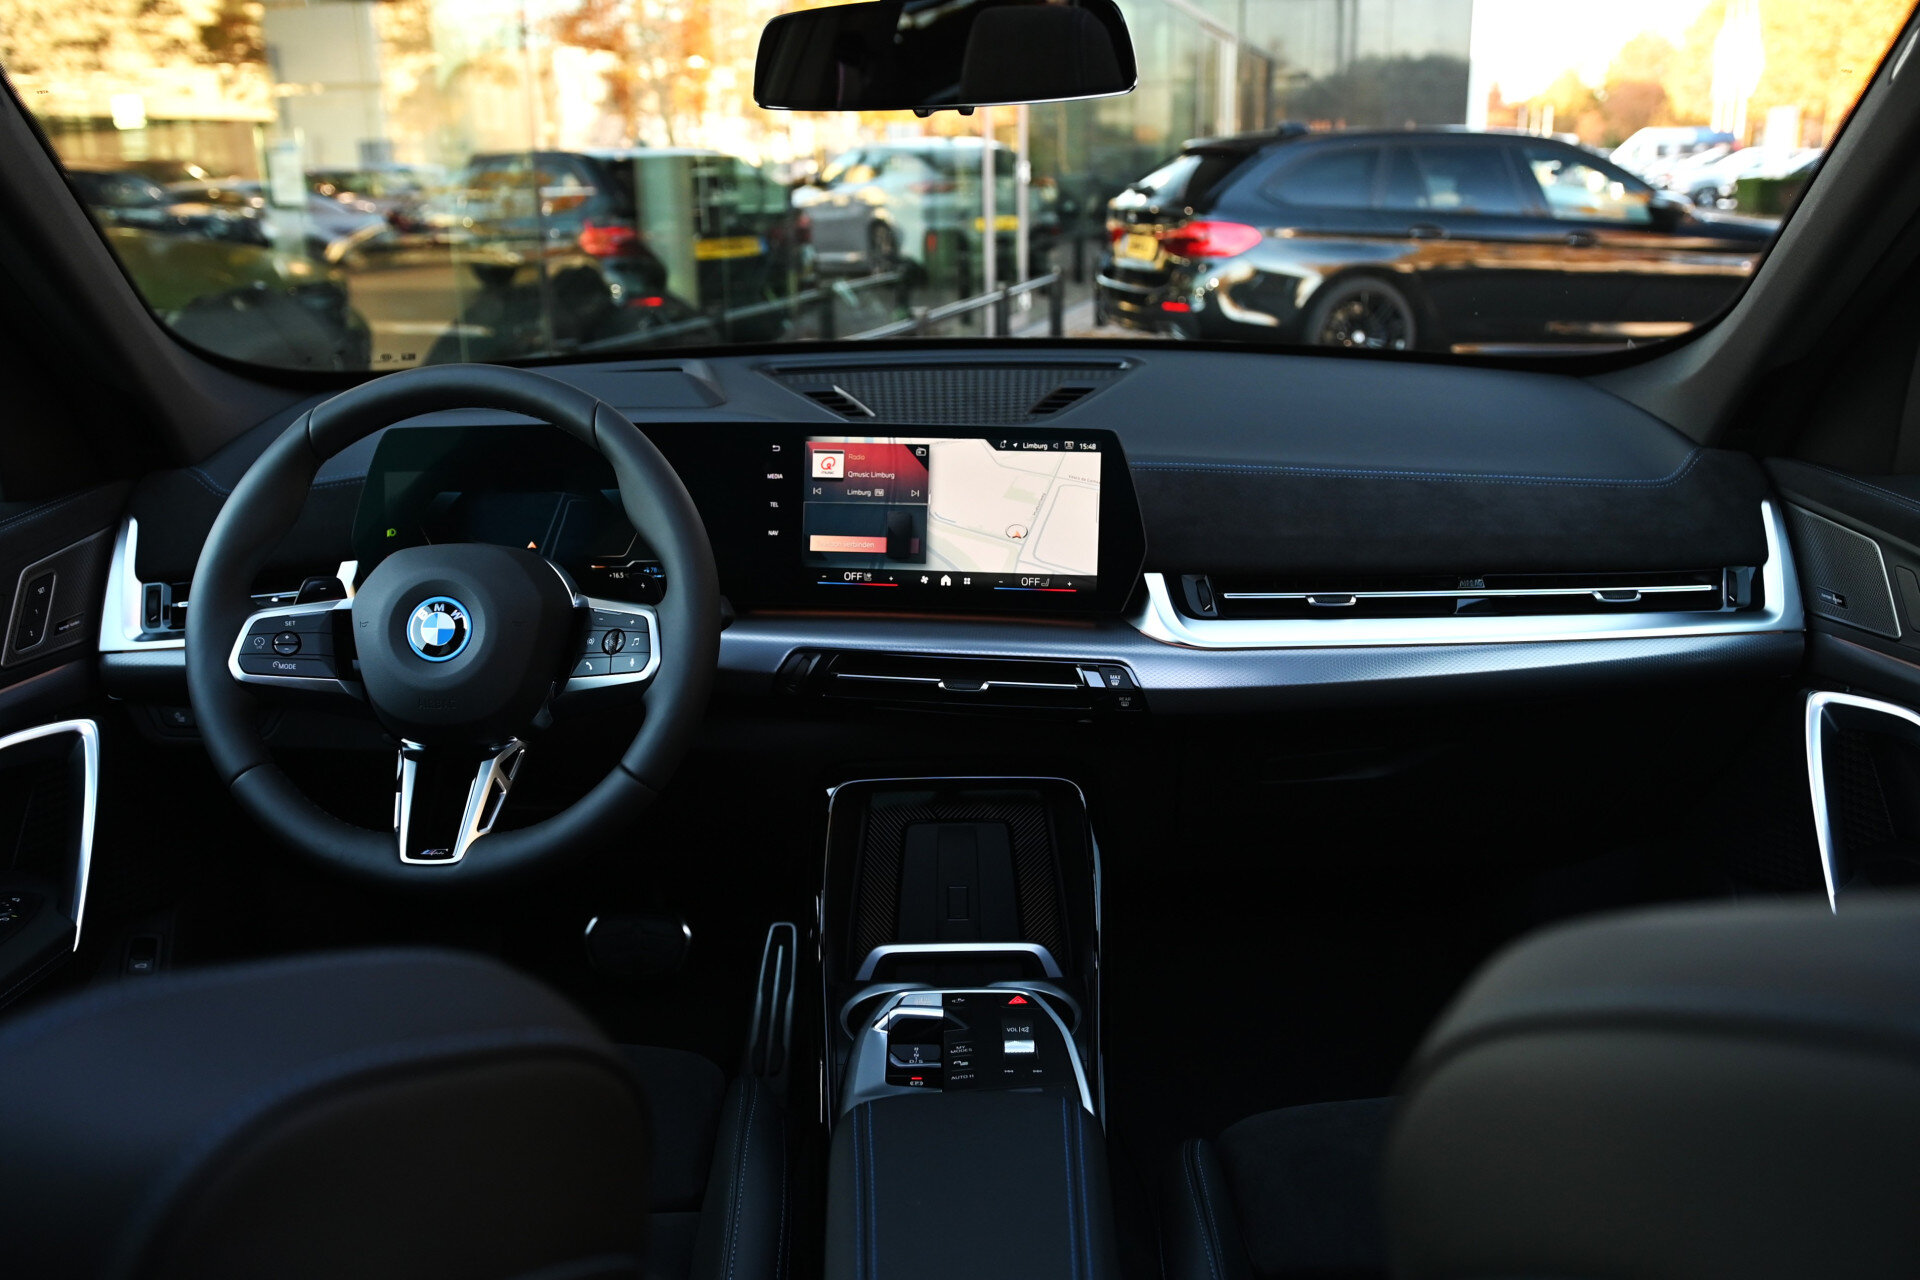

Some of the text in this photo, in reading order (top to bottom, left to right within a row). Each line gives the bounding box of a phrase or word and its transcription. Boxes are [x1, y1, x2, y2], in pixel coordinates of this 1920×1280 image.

[1022, 442, 1048, 450] Limburg
[848, 453, 866, 461] Radio
[847, 471, 896, 480] Qmusic Limburg
[847, 488, 872, 497] Limburg
[843, 572, 863, 581] OFF
[1021, 577, 1041, 586] OFF
[417, 603, 464, 621] BMW
